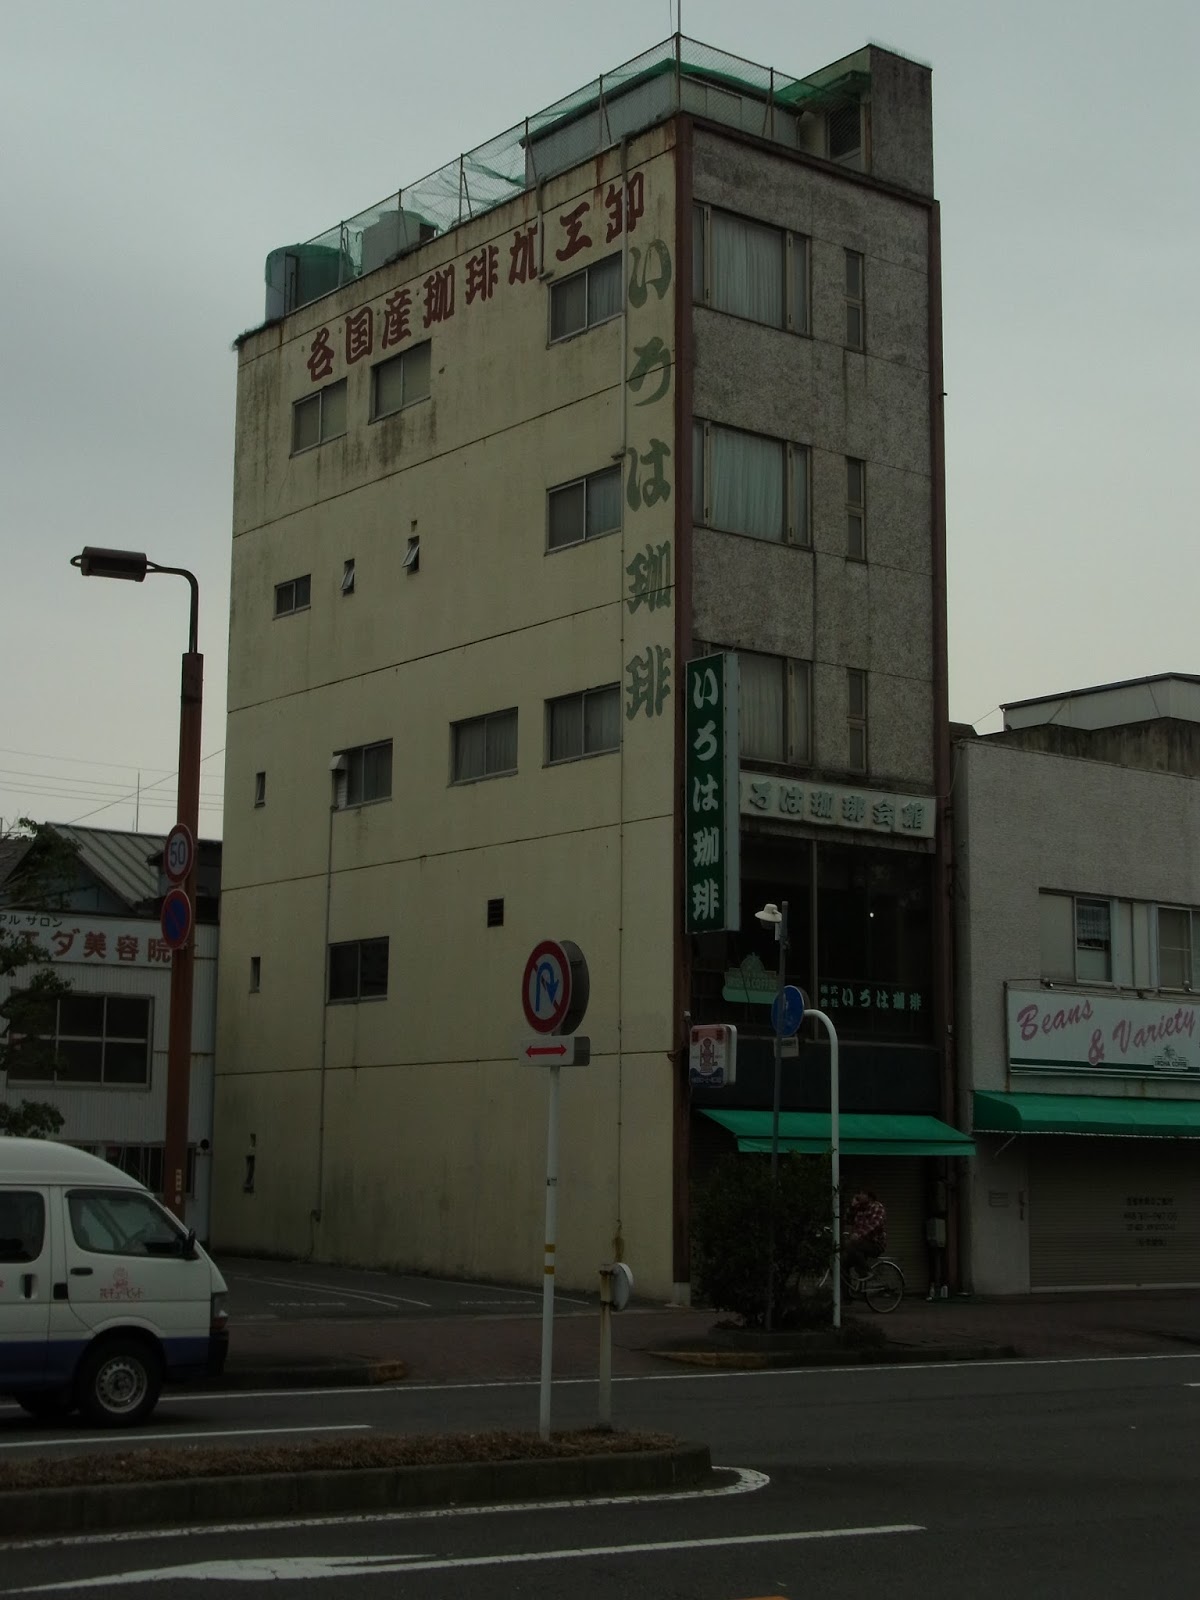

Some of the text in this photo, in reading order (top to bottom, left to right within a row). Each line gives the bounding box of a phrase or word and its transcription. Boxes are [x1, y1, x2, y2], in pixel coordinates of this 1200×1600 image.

[625, 238, 673, 721] いろは珈琲
[692, 667, 720, 921] いろは珈琲
[169, 840, 187, 868] 50
[26, 915, 63, 928] サロン
[841, 987, 923, 1012] いろは珈琲
[1016, 999, 1094, 1042] Beans
[1088, 1007, 1196, 1066] & Variety
